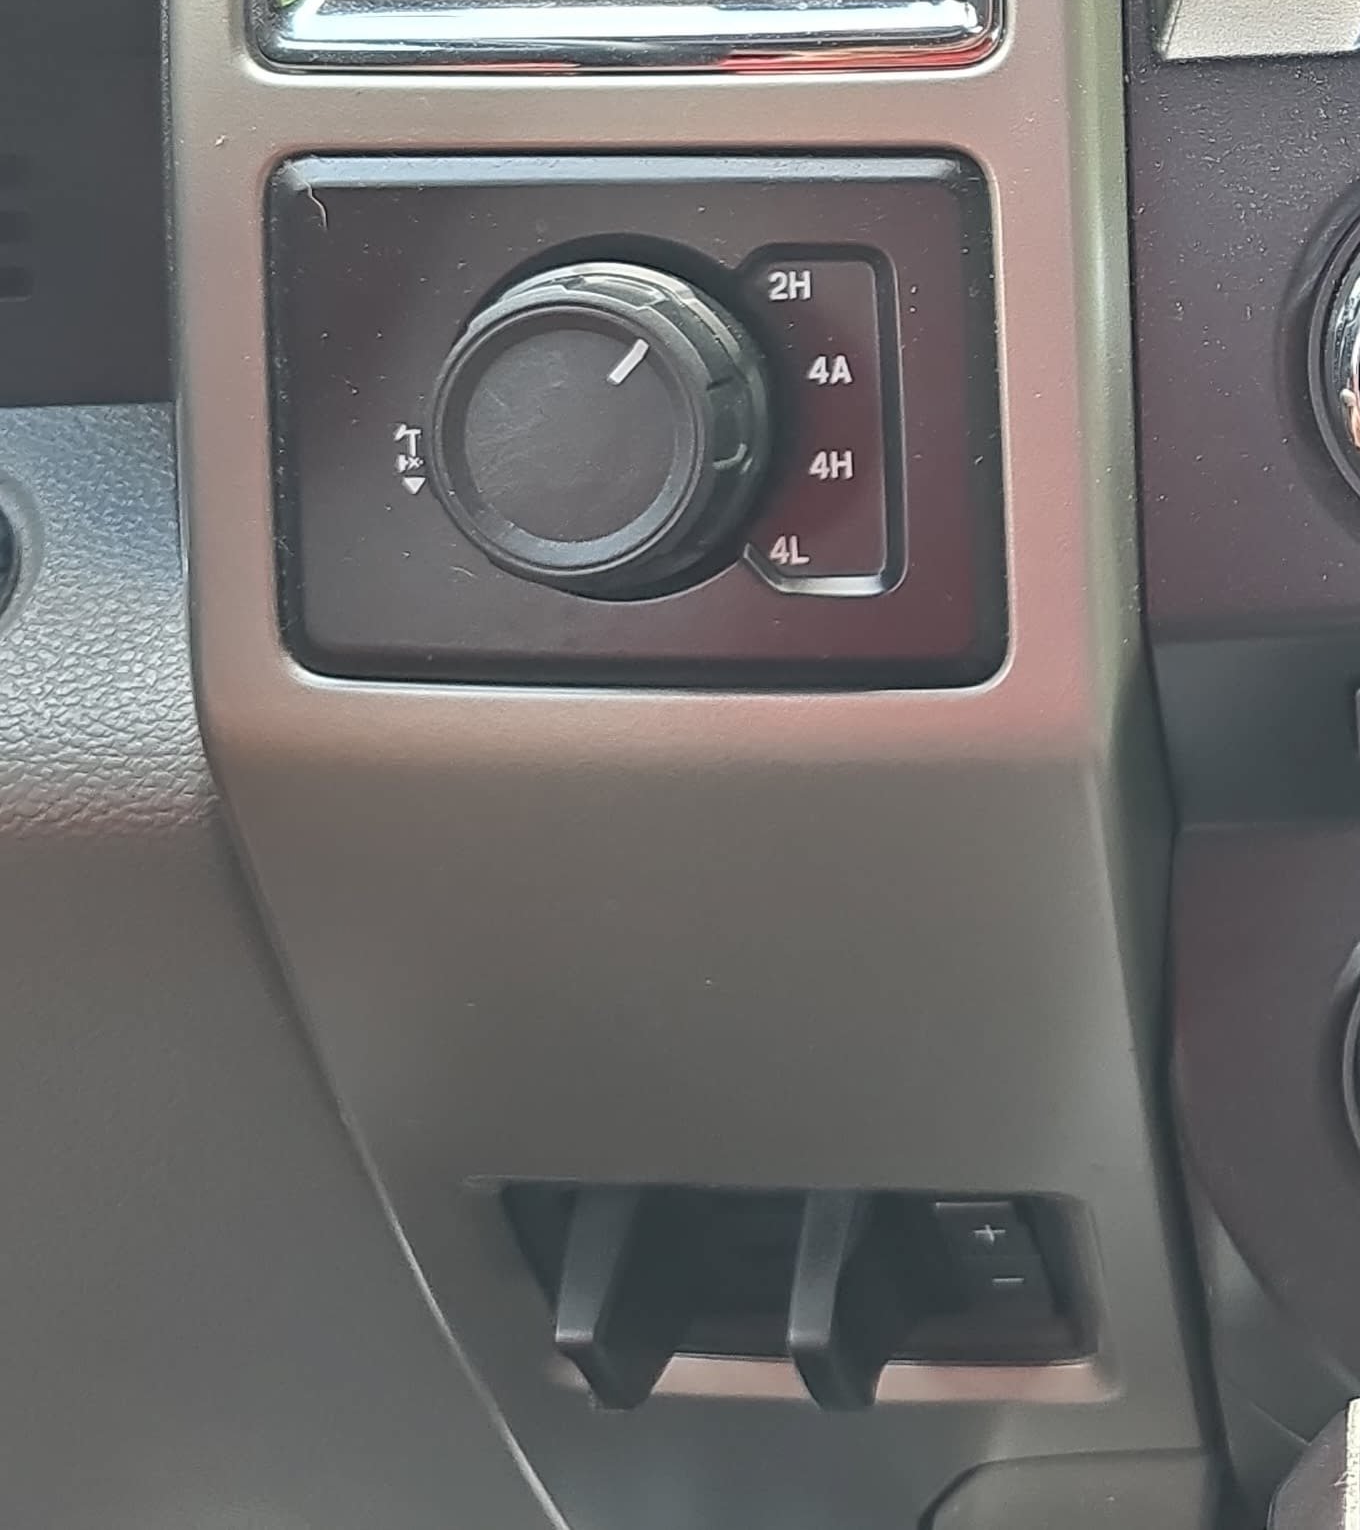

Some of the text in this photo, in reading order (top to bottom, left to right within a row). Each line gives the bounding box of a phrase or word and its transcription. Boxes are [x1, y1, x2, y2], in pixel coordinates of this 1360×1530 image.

[768, 271, 812, 301] 2H
[807, 355, 853, 384] 4A
[809, 451, 854, 480] 4H
[769, 535, 810, 565] 4L
